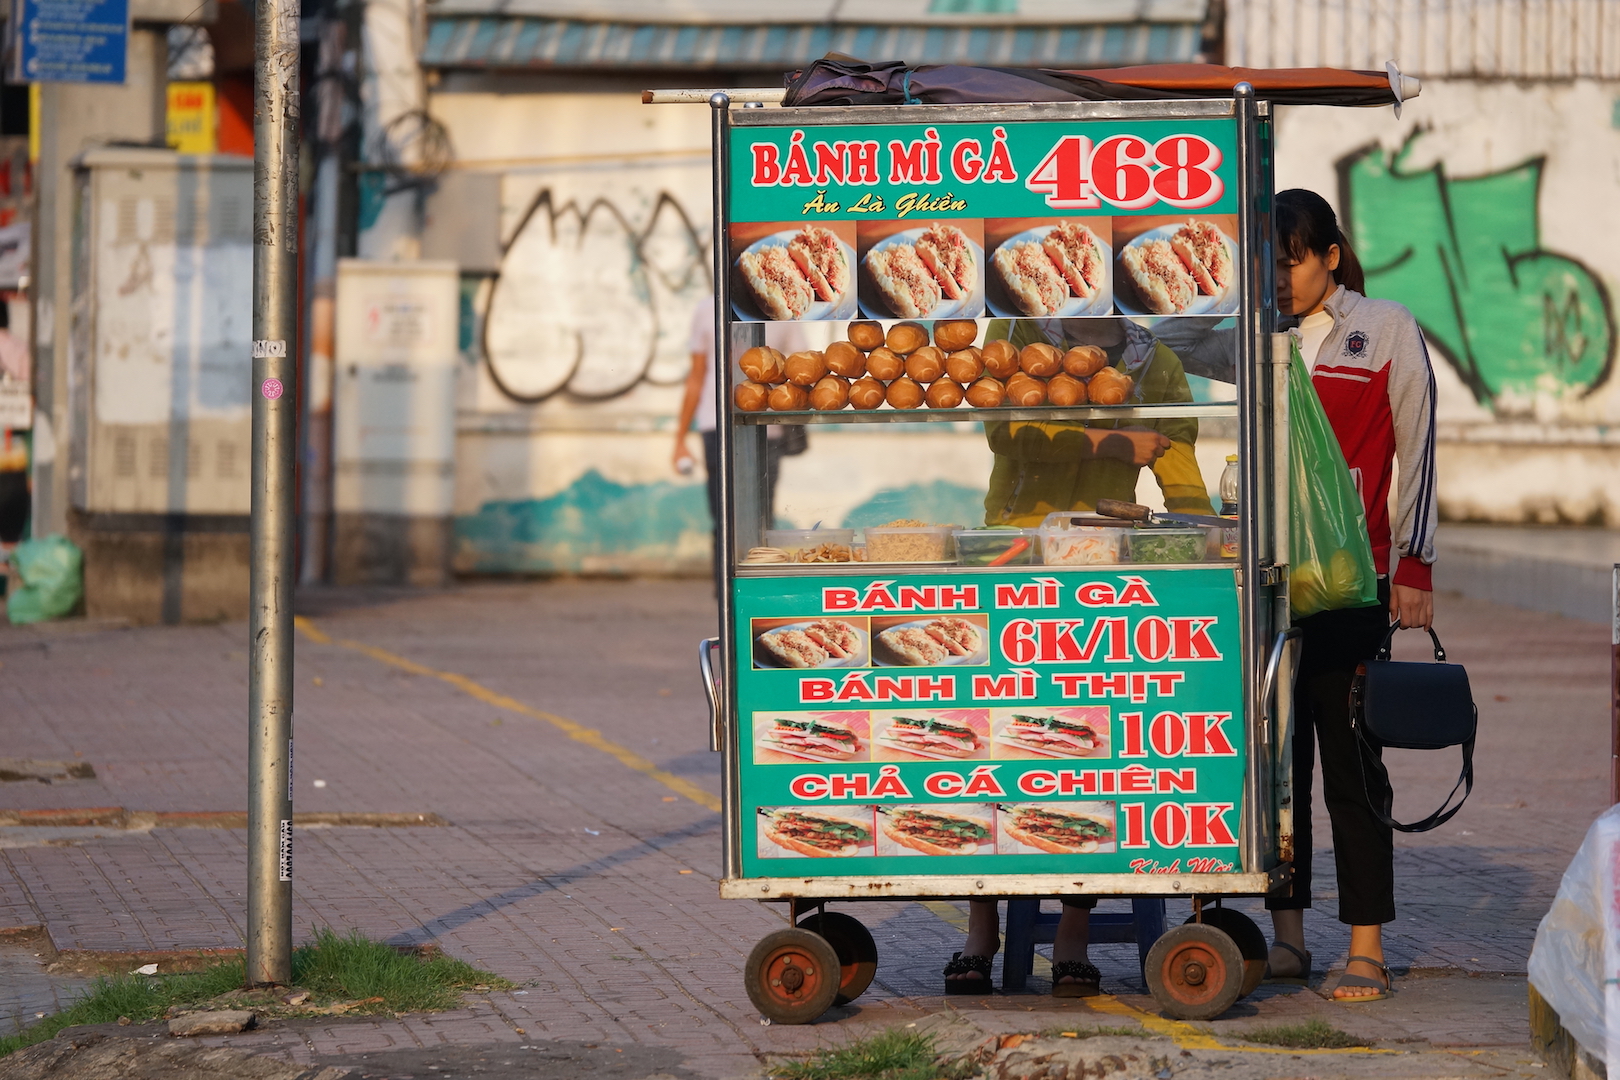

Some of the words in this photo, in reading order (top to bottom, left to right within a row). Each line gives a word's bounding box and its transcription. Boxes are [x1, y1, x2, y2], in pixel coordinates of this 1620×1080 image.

[751, 130, 880, 187] BÁNH
[888, 127, 943, 185] MÌ
[952, 126, 1018, 185] GÀ
[1025, 133, 1225, 210] 468
[802, 190, 840, 215] Ăn
[847, 192, 886, 214] Là
[895, 191, 967, 218] Ghiền
[822, 580, 979, 612] BÁNH
[995, 577, 1064, 609] MÌ
[1075, 576, 1160, 608] GÀ
[1000, 616, 1223, 666] 6K/10K
[799, 671, 956, 703] BÁNH
[972, 668, 1041, 700] MÌ
[1052, 671, 1185, 704] THỊT
[1119, 710, 1238, 759] 10K
[789, 764, 913, 800] CHẢ
[924, 765, 1007, 798] CÁ
[1017, 763, 1197, 796] CHIÊN
[1120, 801, 1239, 849] 10K
